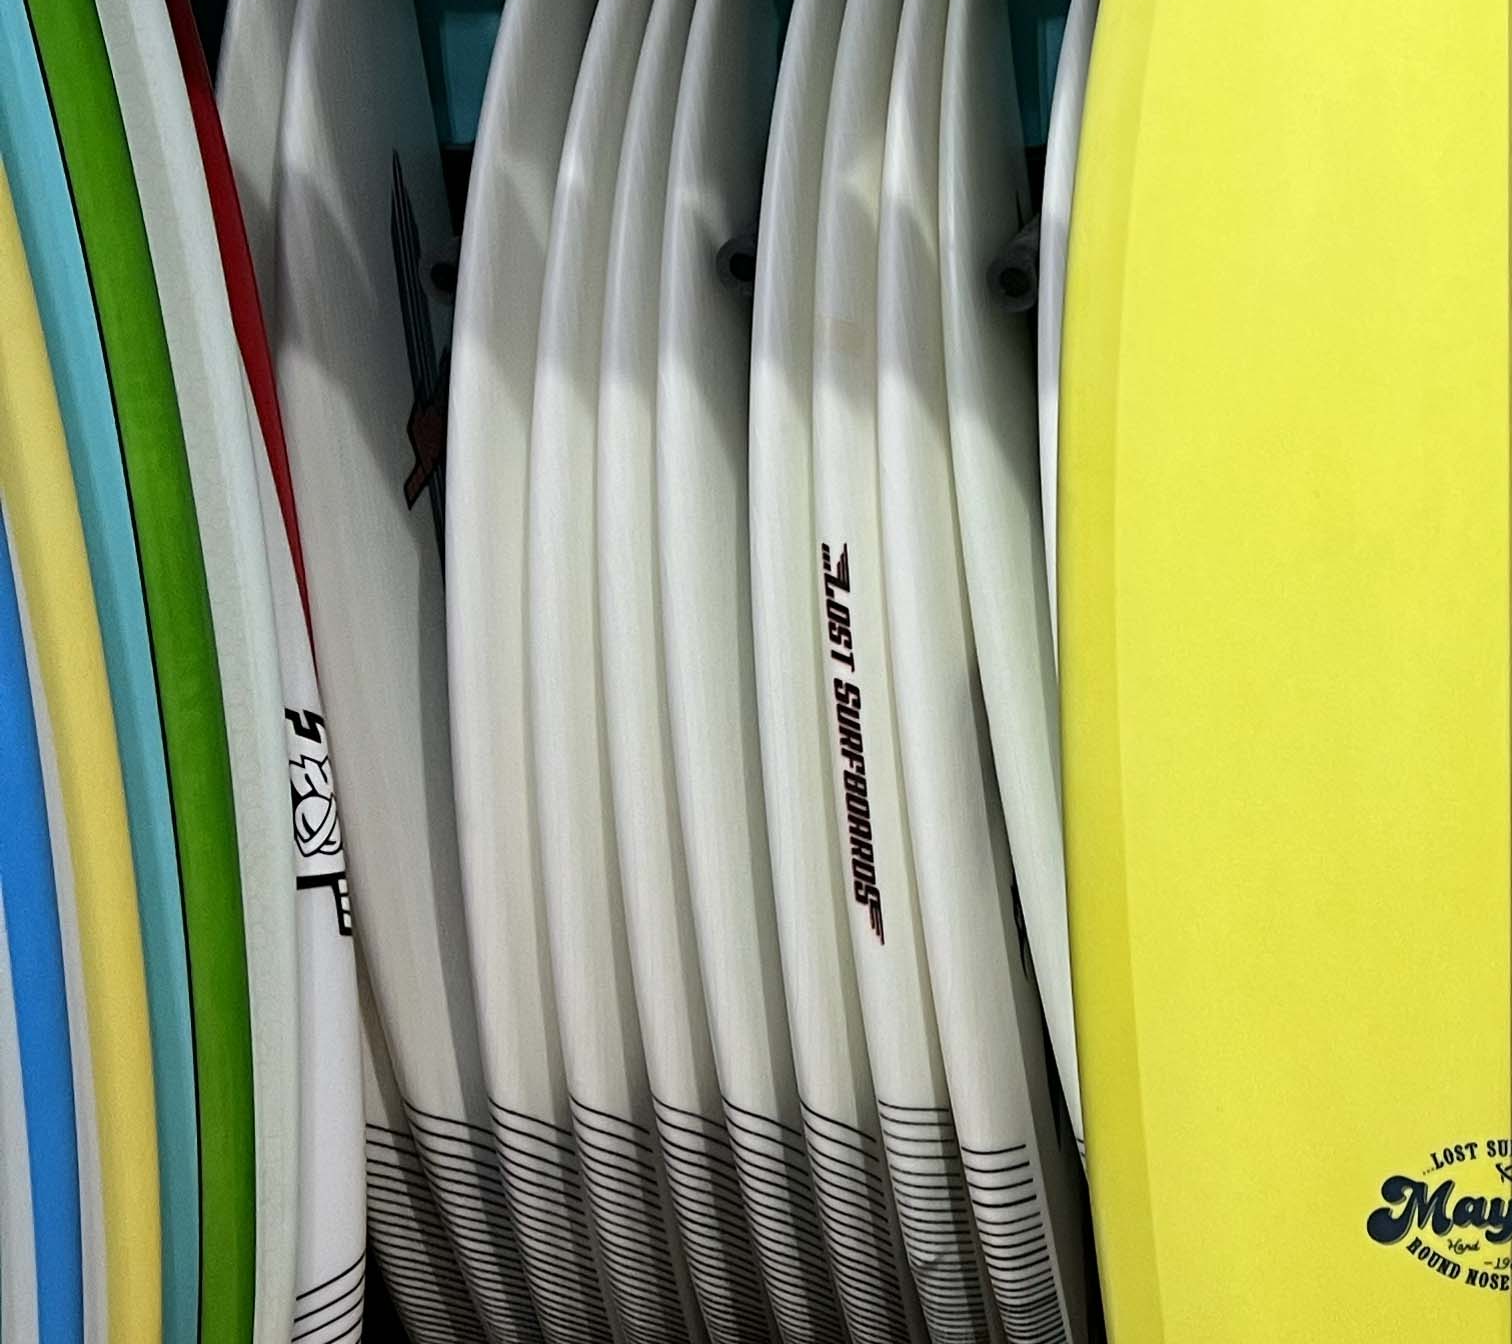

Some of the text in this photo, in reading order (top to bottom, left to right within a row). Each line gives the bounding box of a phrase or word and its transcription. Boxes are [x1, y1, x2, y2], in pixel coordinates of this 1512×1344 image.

[833, 677, 884, 945] SURFBOARDS
[1405, 1236, 1462, 1280] ROUND
[1465, 1267, 1511, 1291] NOSE
